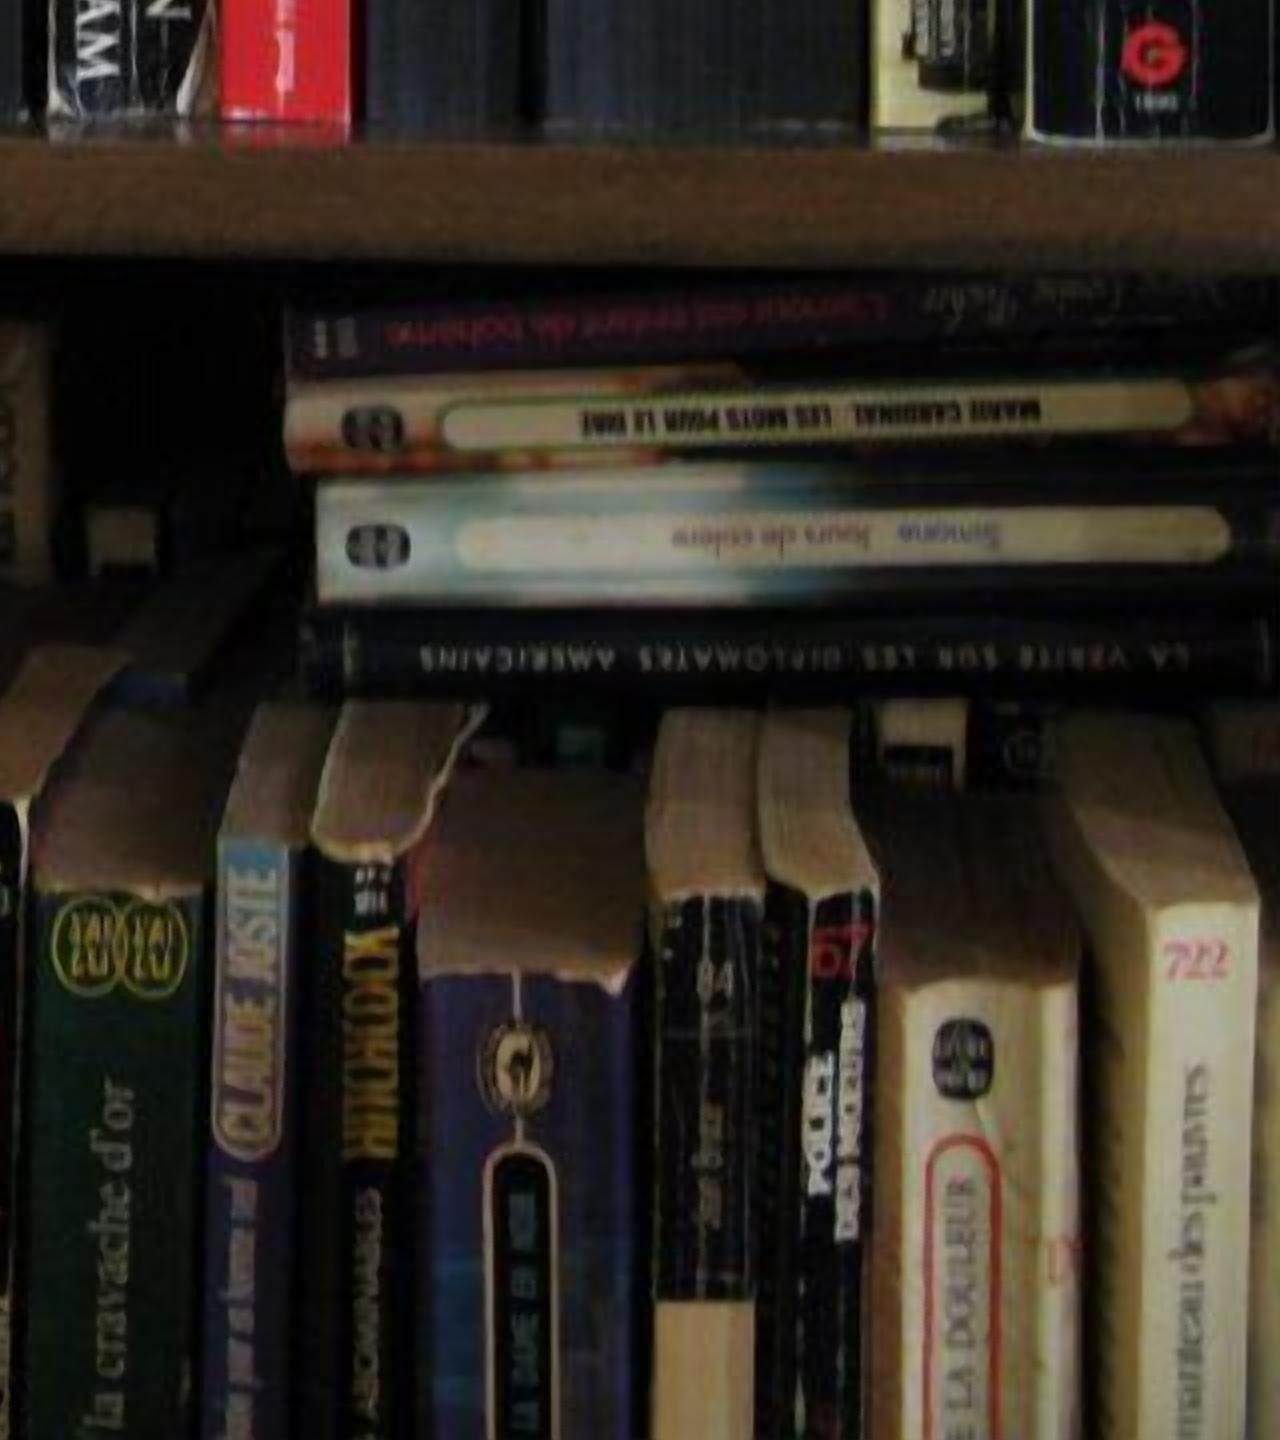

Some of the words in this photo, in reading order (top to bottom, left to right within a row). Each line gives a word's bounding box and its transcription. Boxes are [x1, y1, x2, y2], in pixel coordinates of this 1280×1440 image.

[1162, 942, 1229, 980] 722
[88, 1181, 131, 1378] cravache
[944, 1178, 977, 1348] DOULEUR
[83, 1392, 125, 1431] la
